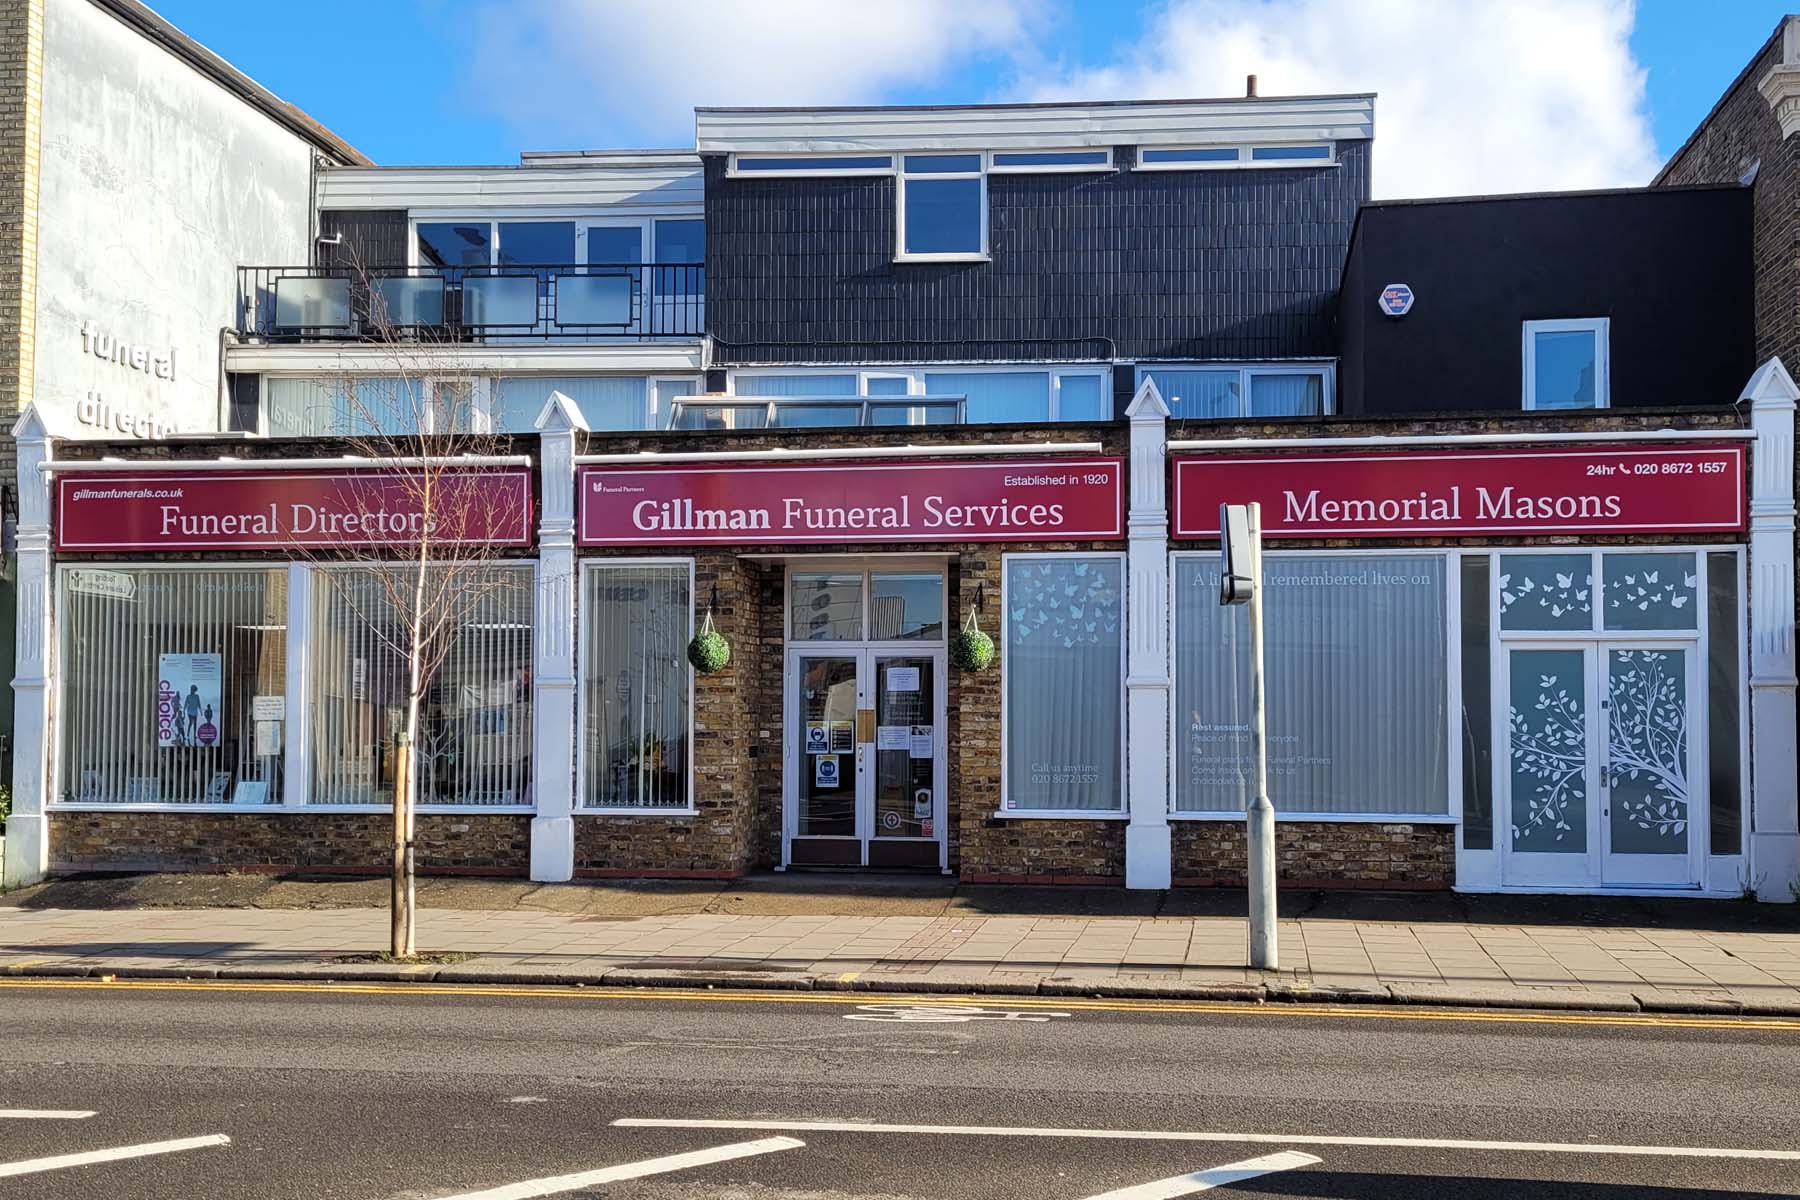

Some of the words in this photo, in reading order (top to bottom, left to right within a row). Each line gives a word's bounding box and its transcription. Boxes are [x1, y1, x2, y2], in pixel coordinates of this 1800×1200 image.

[80, 319, 178, 382] funeral
[1586, 464, 1617, 476] 24hr
[1634, 463, 1659, 475] 020
[1661, 463, 1694, 474] 8672
[1697, 462, 1728, 474] 1557
[1004, 474, 1066, 487] Established
[1069, 474, 1079, 486] in
[1082, 473, 1109, 485] 1920
[72, 487, 184, 501] gillmanfunerals.co.uk
[1282, 486, 1462, 522] Memorial
[1475, 486, 1622, 519] Masons
[159, 503, 279, 535] Funeral
[290, 503, 436, 534] Directors
[632, 499, 770, 531] Gillman
[782, 495, 910, 529] Funeral
[923, 494, 1064, 527] Services
[1192, 573, 1205, 586] A
[1271, 570, 1367, 586] remembered
[1371, 570, 1406, 586] lives
[1411, 574, 1432, 586] on
[159, 679, 175, 741] choice
[1191, 723, 1212, 731] Rest
[1031, 761, 1049, 773] Call
[1031, 773, 1050, 784] 020
[1052, 773, 1076, 784] 8672
[1077, 773, 1099, 784] 1557
